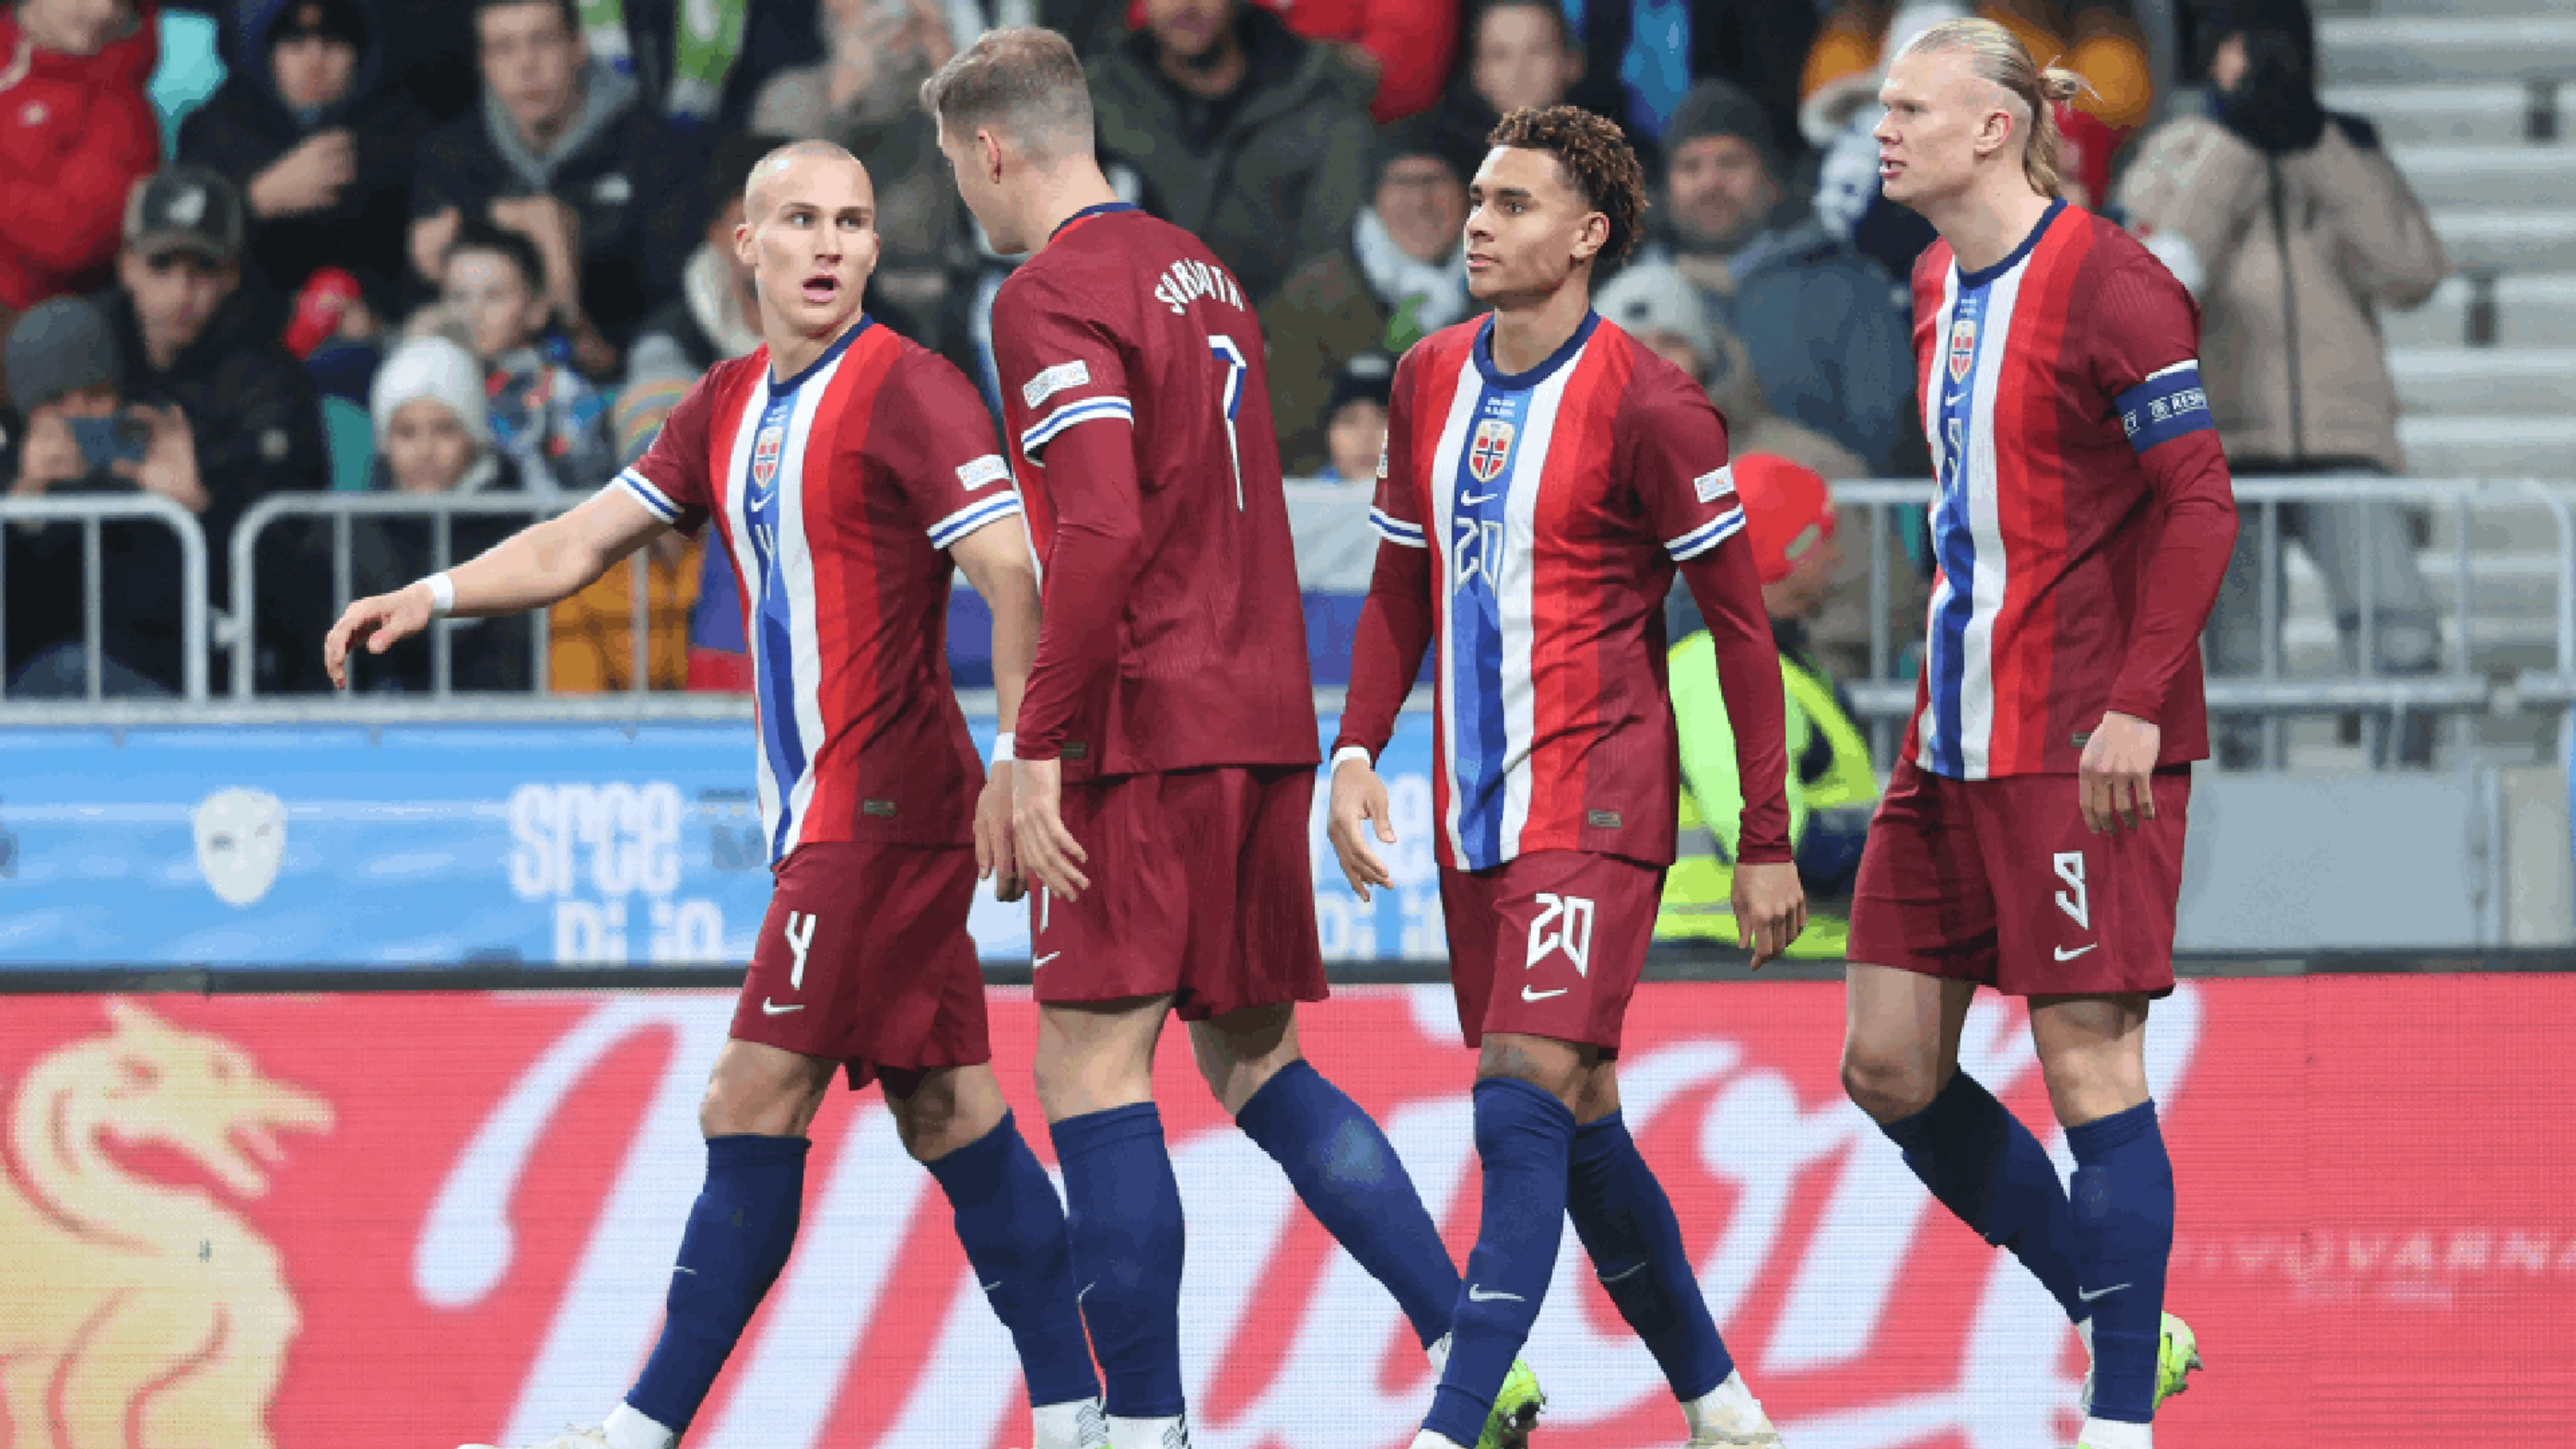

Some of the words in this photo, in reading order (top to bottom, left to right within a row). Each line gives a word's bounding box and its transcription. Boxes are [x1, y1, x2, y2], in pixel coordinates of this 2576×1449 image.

[1208, 335, 1246, 512] 7
[1452, 517, 1503, 598] 20
[2053, 851, 2090, 930] 9
[784, 910, 816, 990] 4
[1527, 893, 1595, 978] 20
